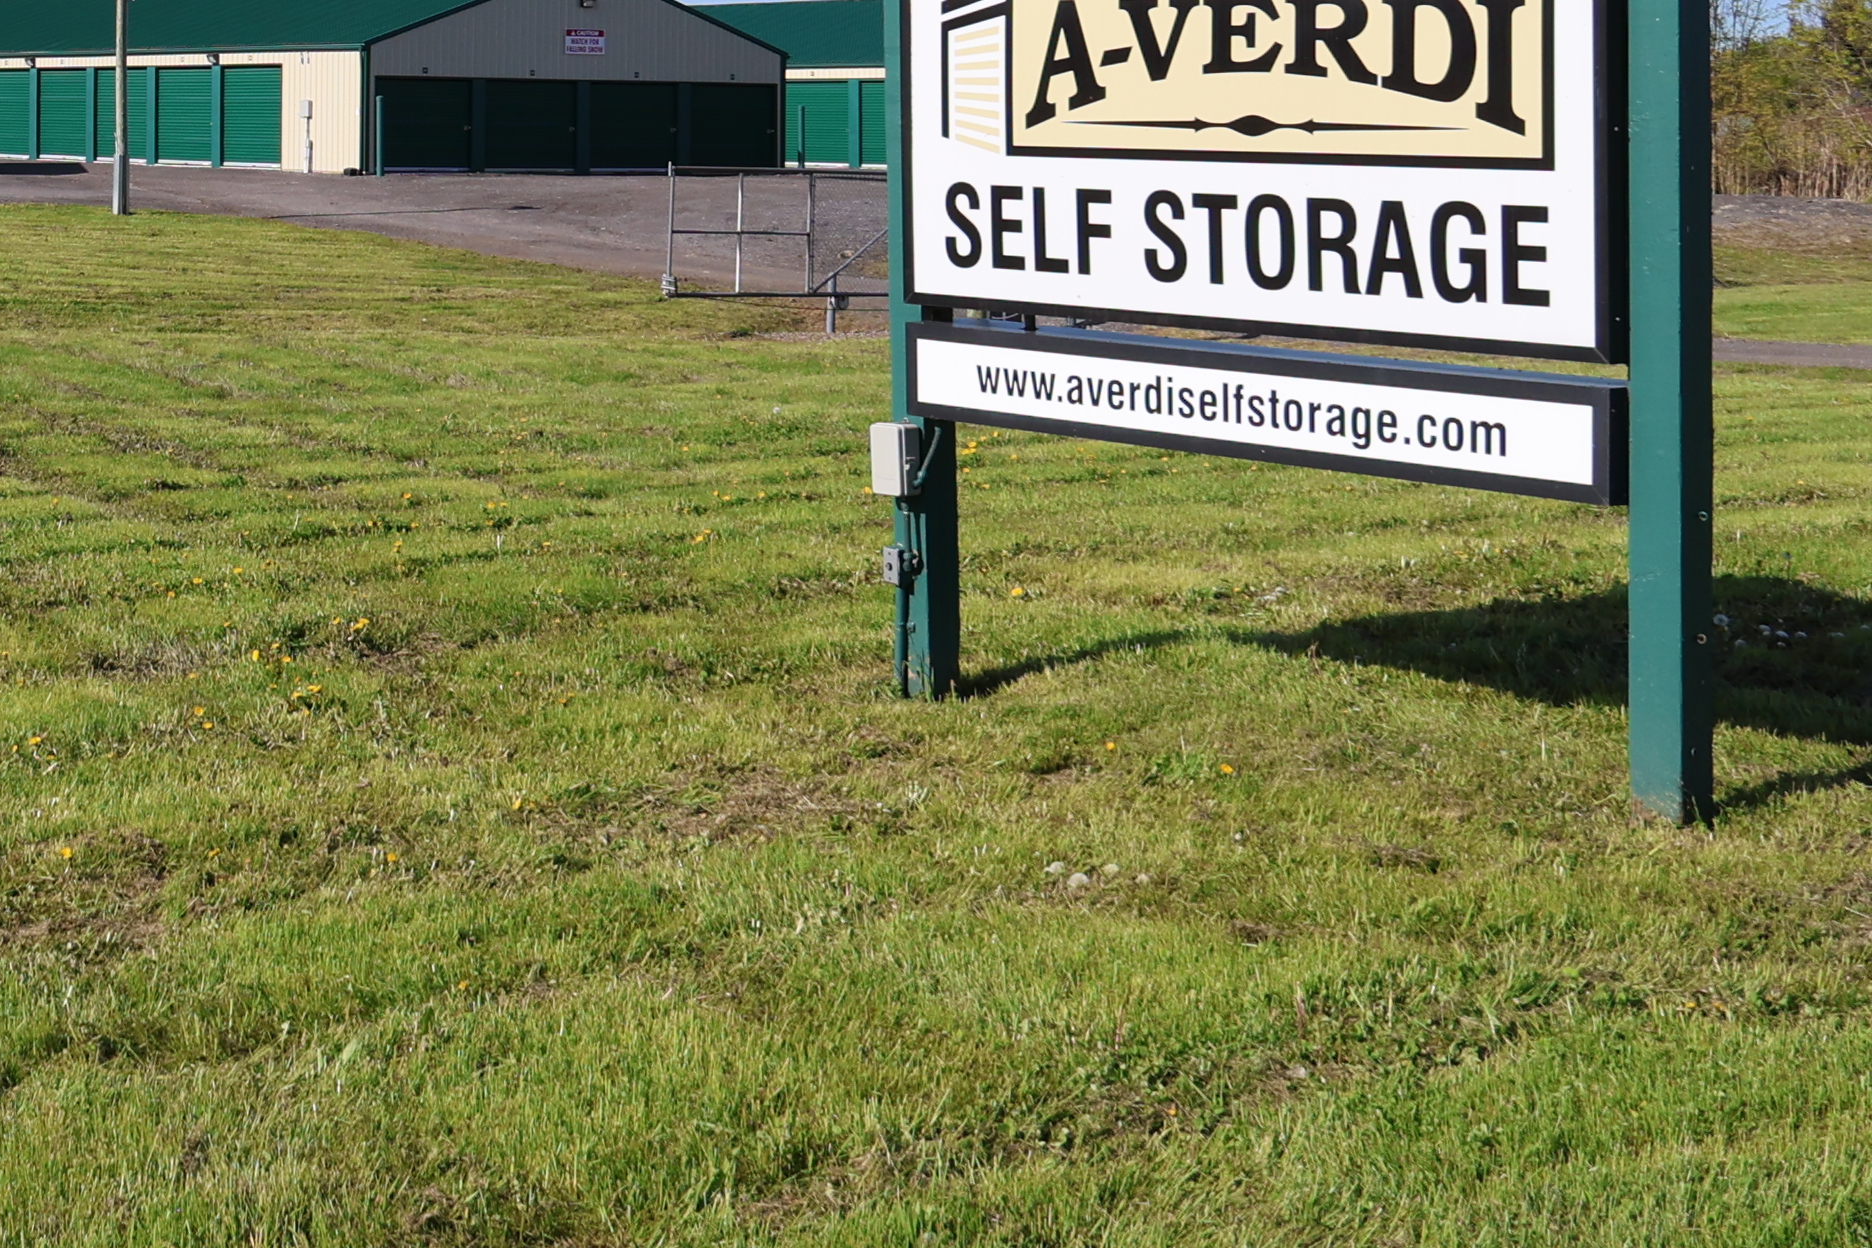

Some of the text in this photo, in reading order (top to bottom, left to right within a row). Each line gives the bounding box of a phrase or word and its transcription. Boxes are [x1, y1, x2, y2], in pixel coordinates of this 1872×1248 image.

[945, 181, 1551, 308] SELF STORAGE
[976, 364, 1507, 458] www.averdiselfstorage.com
